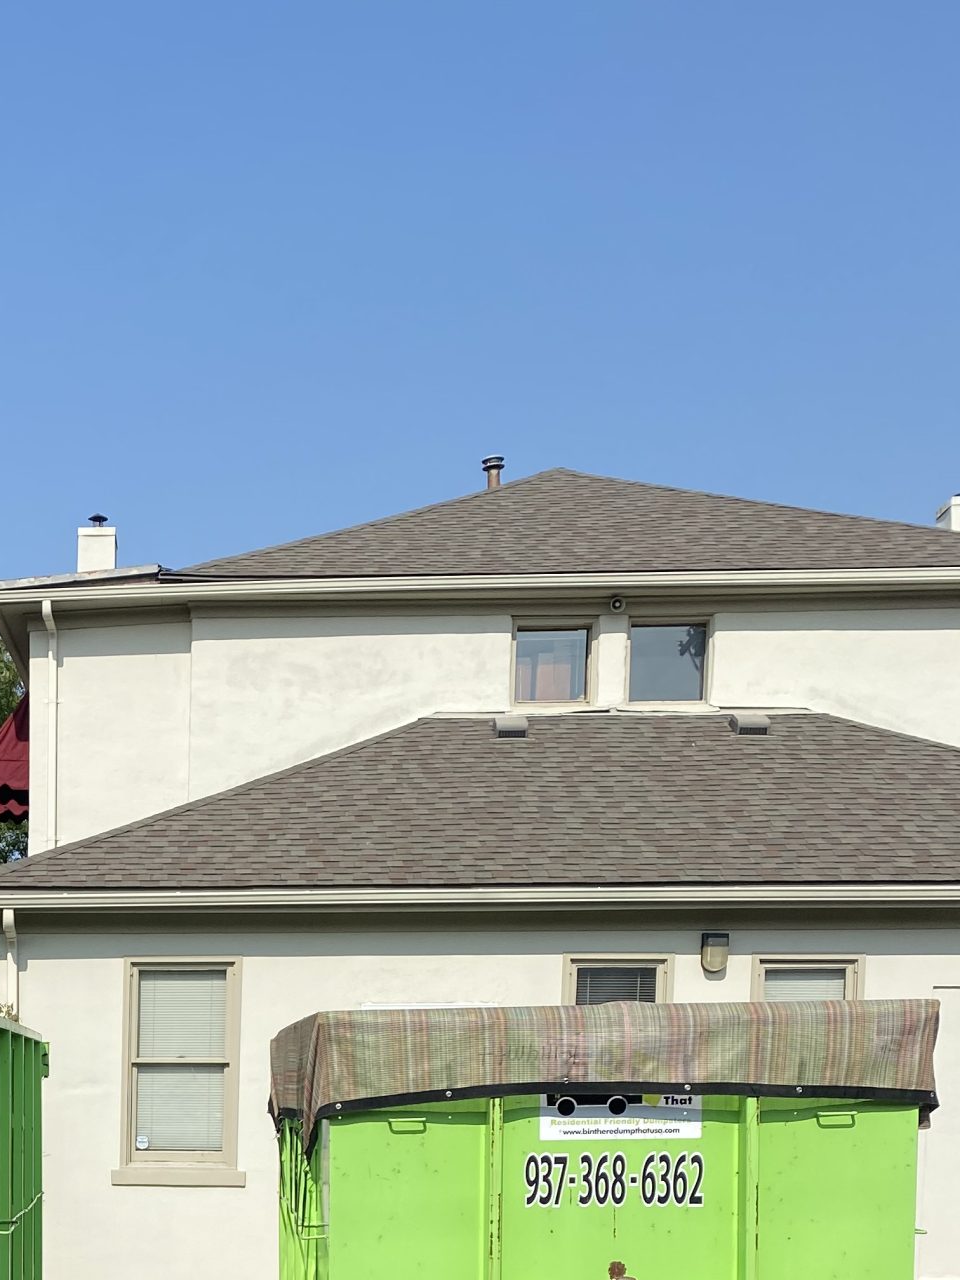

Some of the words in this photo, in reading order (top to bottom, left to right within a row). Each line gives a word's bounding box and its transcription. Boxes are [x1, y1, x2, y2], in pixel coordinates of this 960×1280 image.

[663, 1096, 693, 1105] That
[550, 1118, 602, 1127] Residential
[604, 1118, 640, 1127] Friendly
[562, 1127, 680, 1136] www.bintheredumpthatusa.com
[524, 1153, 704, 1206] 937-368-6362
